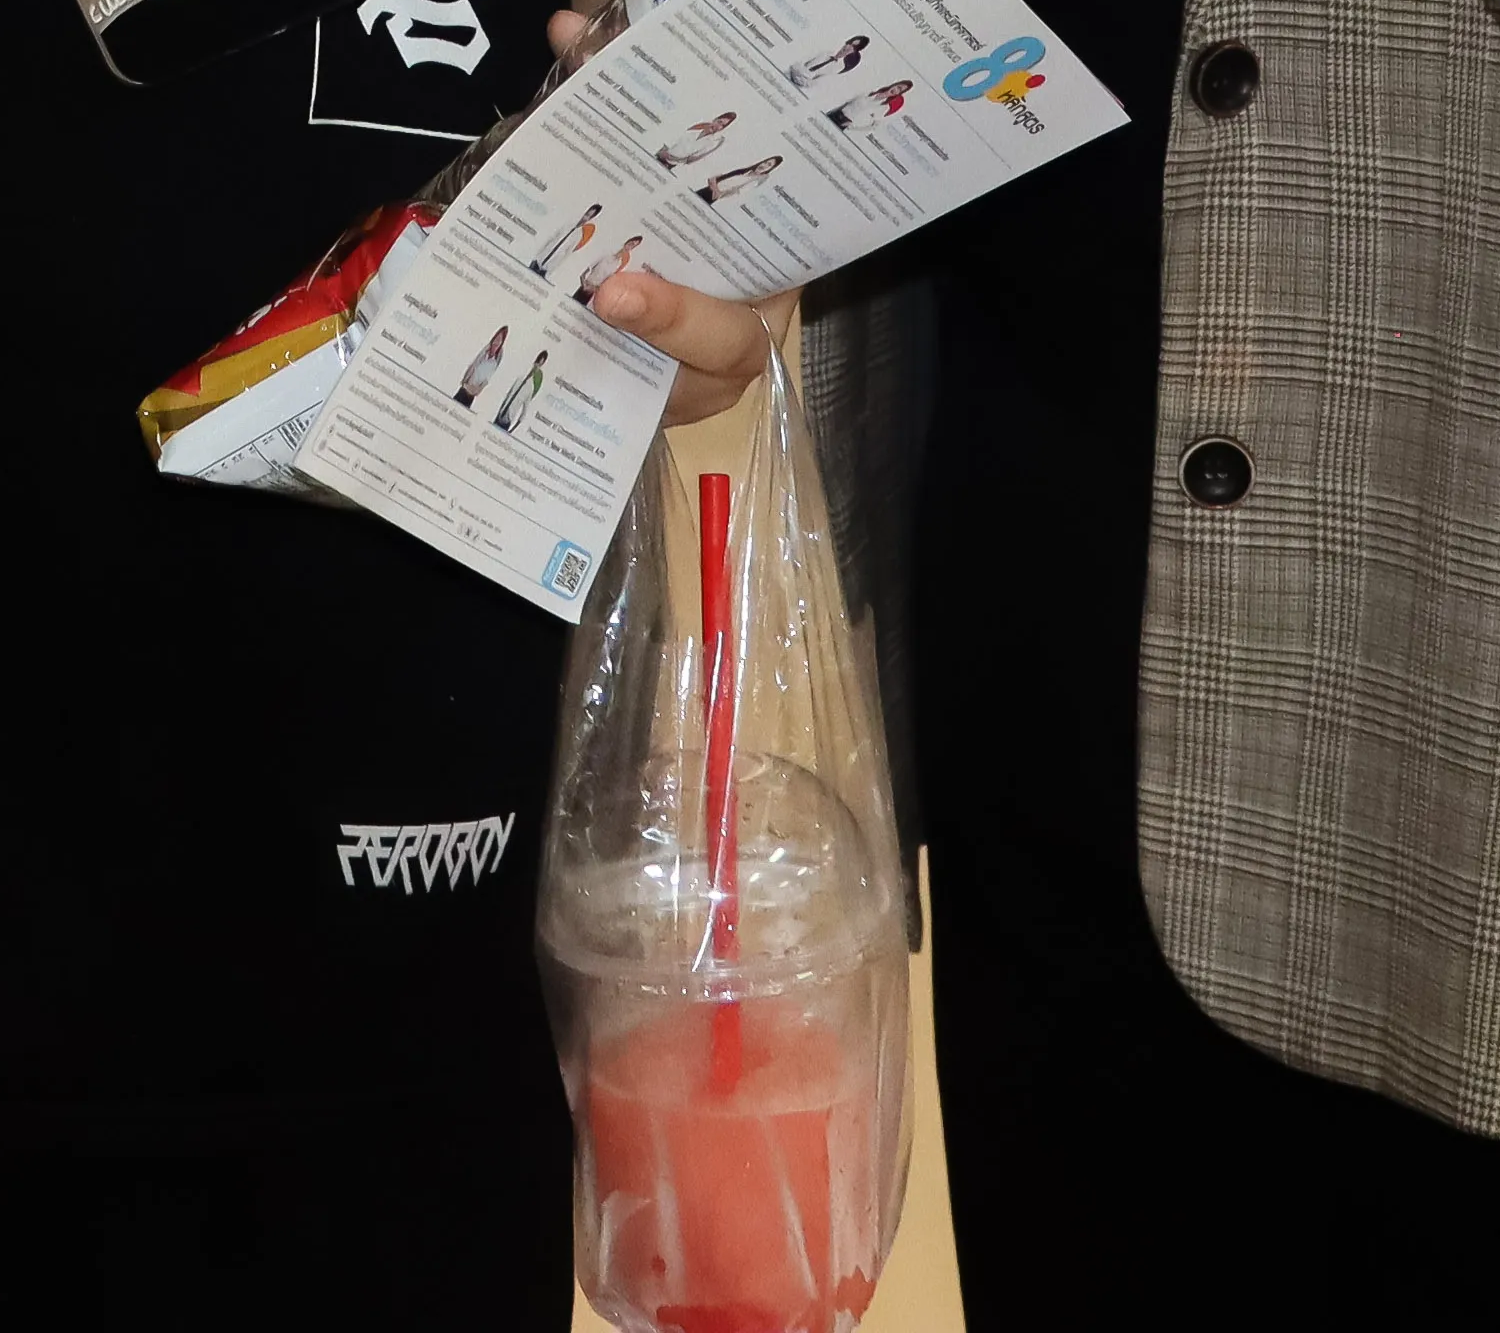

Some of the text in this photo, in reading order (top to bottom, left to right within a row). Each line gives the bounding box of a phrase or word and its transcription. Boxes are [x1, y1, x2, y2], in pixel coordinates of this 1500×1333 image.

[943, 36, 1047, 135] 8 หลักสูตร
